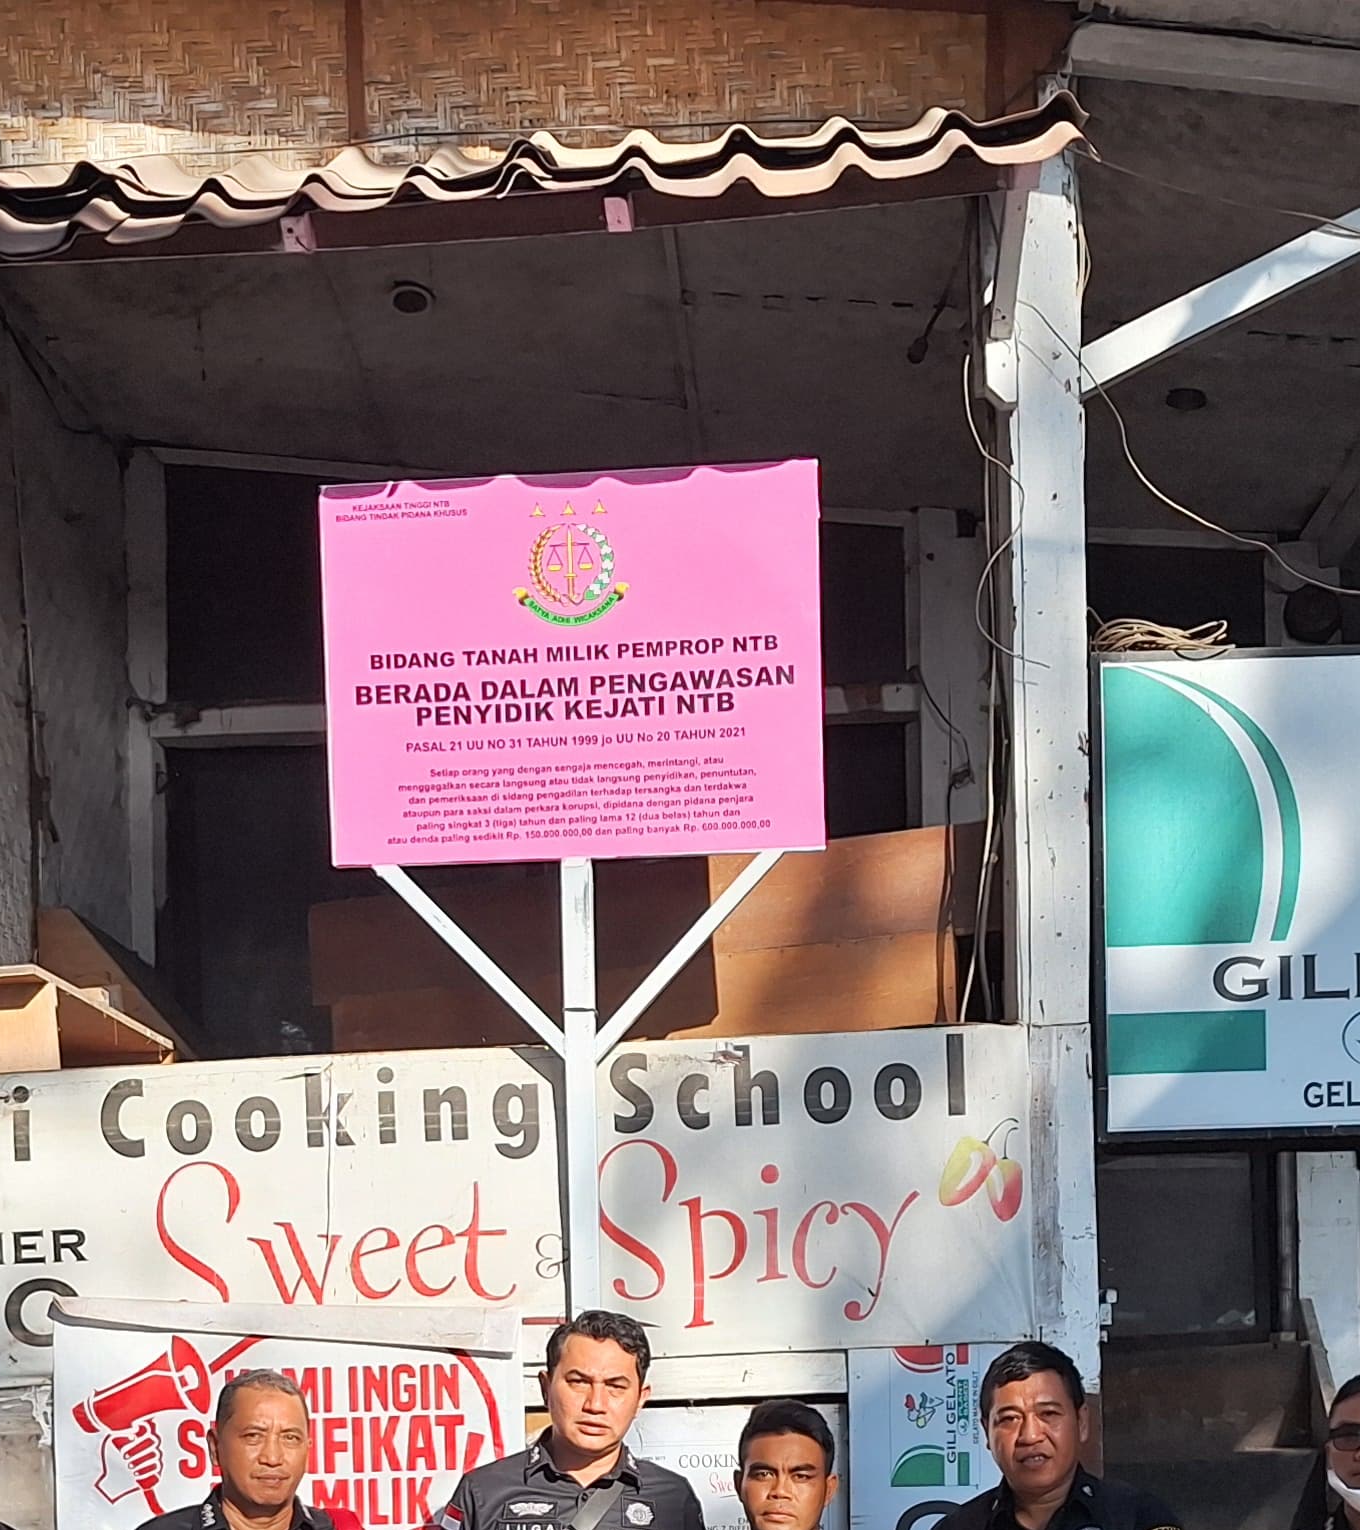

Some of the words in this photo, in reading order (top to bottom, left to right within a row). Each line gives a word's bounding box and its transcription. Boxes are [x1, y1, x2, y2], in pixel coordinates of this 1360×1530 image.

[370, 652, 455, 670] BIDANG
[462, 648, 538, 666] TANAH
[546, 644, 610, 663] MILIK
[618, 638, 724, 659] PEMPROP
[733, 635, 778, 653] NTB
[355, 682, 471, 706] BERADA
[482, 676, 578, 701] DALAM
[590, 665, 794, 696] PENGAWASAN
[416, 701, 554, 727] PENYIDIK
[564, 696, 664, 720] KEJATI
[677, 692, 734, 715] NTB
[406, 741, 447, 752] PASAL
[450, 741, 462, 752] 21
[466, 740, 484, 750] UU
[488, 739, 506, 749] NO
[509, 738, 522, 749] 31
[526, 736, 567, 748] TAHUN
[572, 735, 598, 746] 1999
[602, 734, 612, 746] jo
[616, 733, 633, 744] UU
[638, 732, 653, 743] No
[657, 731, 670, 742] 20
[674, 728, 715, 741] TAHUN
[720, 727, 745, 738] 2021
[100, 1066, 540, 1159] Cooking
[608, 1033, 967, 1134] School
[156, 1160, 516, 1304] Sweet
[599, 1138, 921, 1329] Spicy
[348, 1363, 460, 1412] INGIN
[945, 1352, 957, 1425] GELATO
[678, 1454, 740, 1469] COOKIN
[946, 1429, 957, 1464] GILI
[311, 1477, 433, 1526] MILIK
